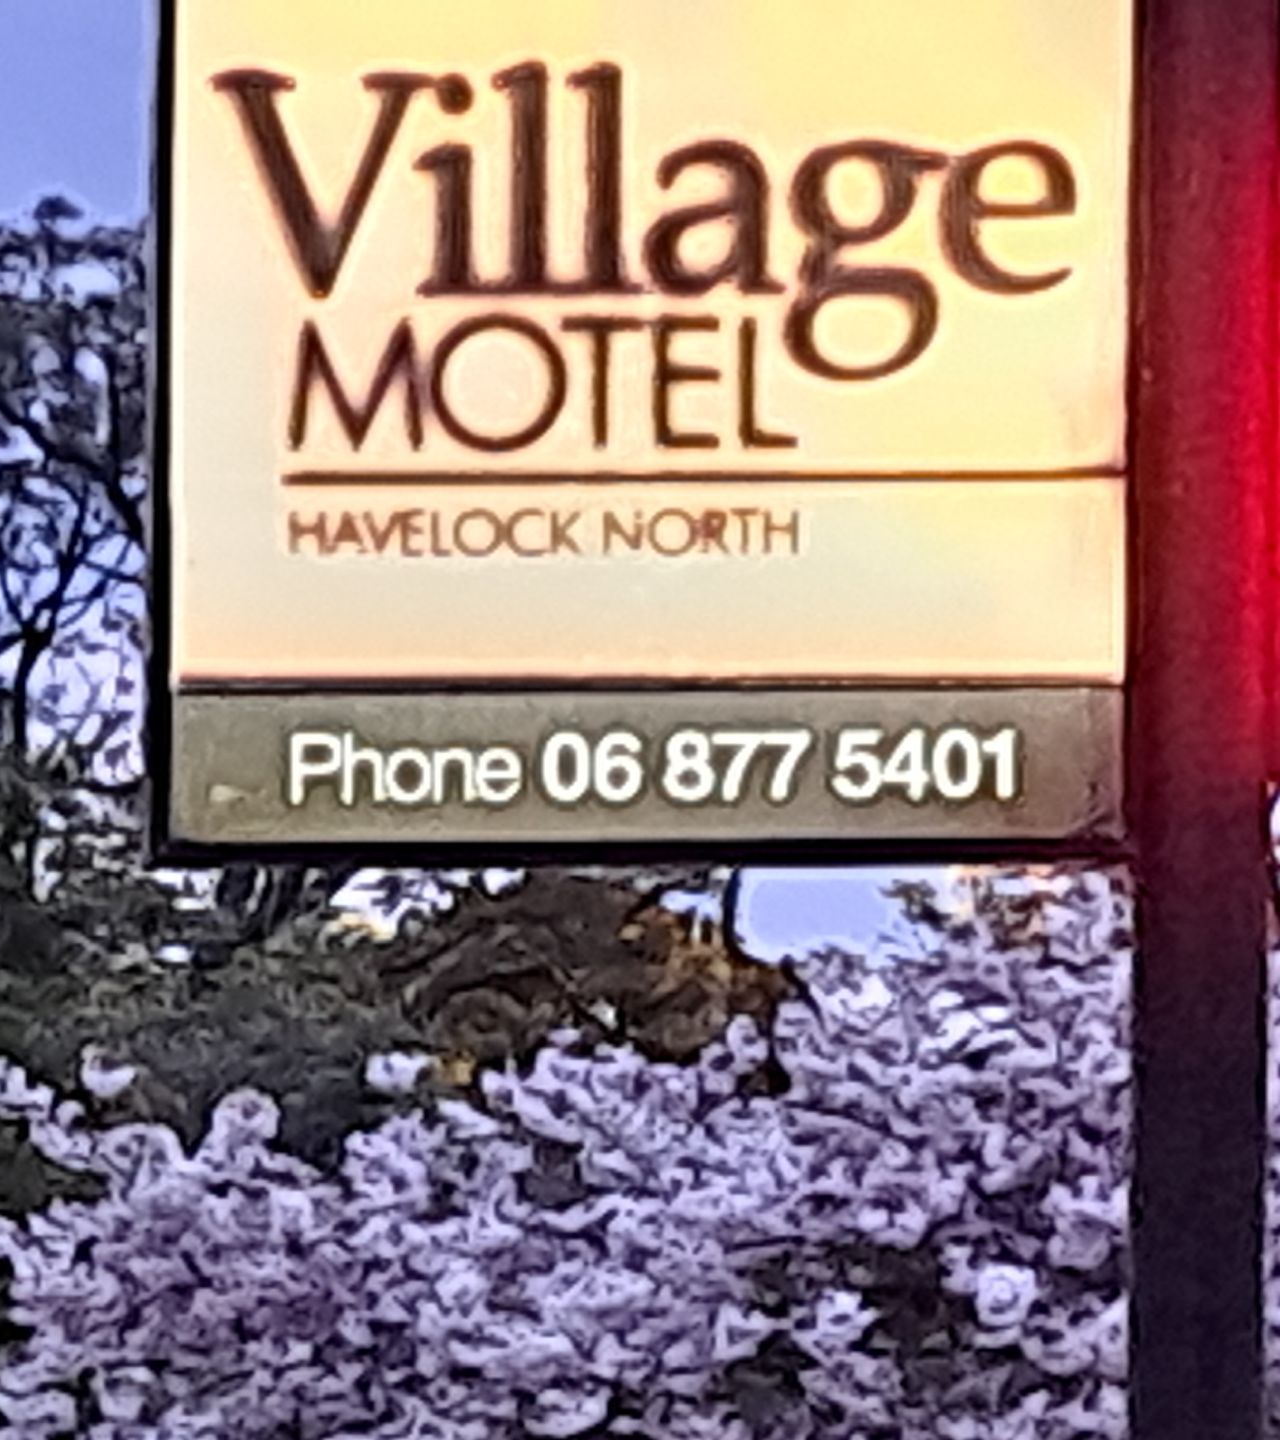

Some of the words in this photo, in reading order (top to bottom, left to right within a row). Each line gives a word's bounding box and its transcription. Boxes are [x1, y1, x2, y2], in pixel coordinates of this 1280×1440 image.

[209, 60, 1077, 382] Village
[286, 313, 799, 453] MOTEL
[288, 508, 580, 557] HAVELOCK
[602, 508, 799, 556] NORTH
[289, 732, 522, 804] Phone
[542, 731, 642, 802] 06
[662, 729, 811, 802] 877
[831, 729, 1018, 801] 5401
